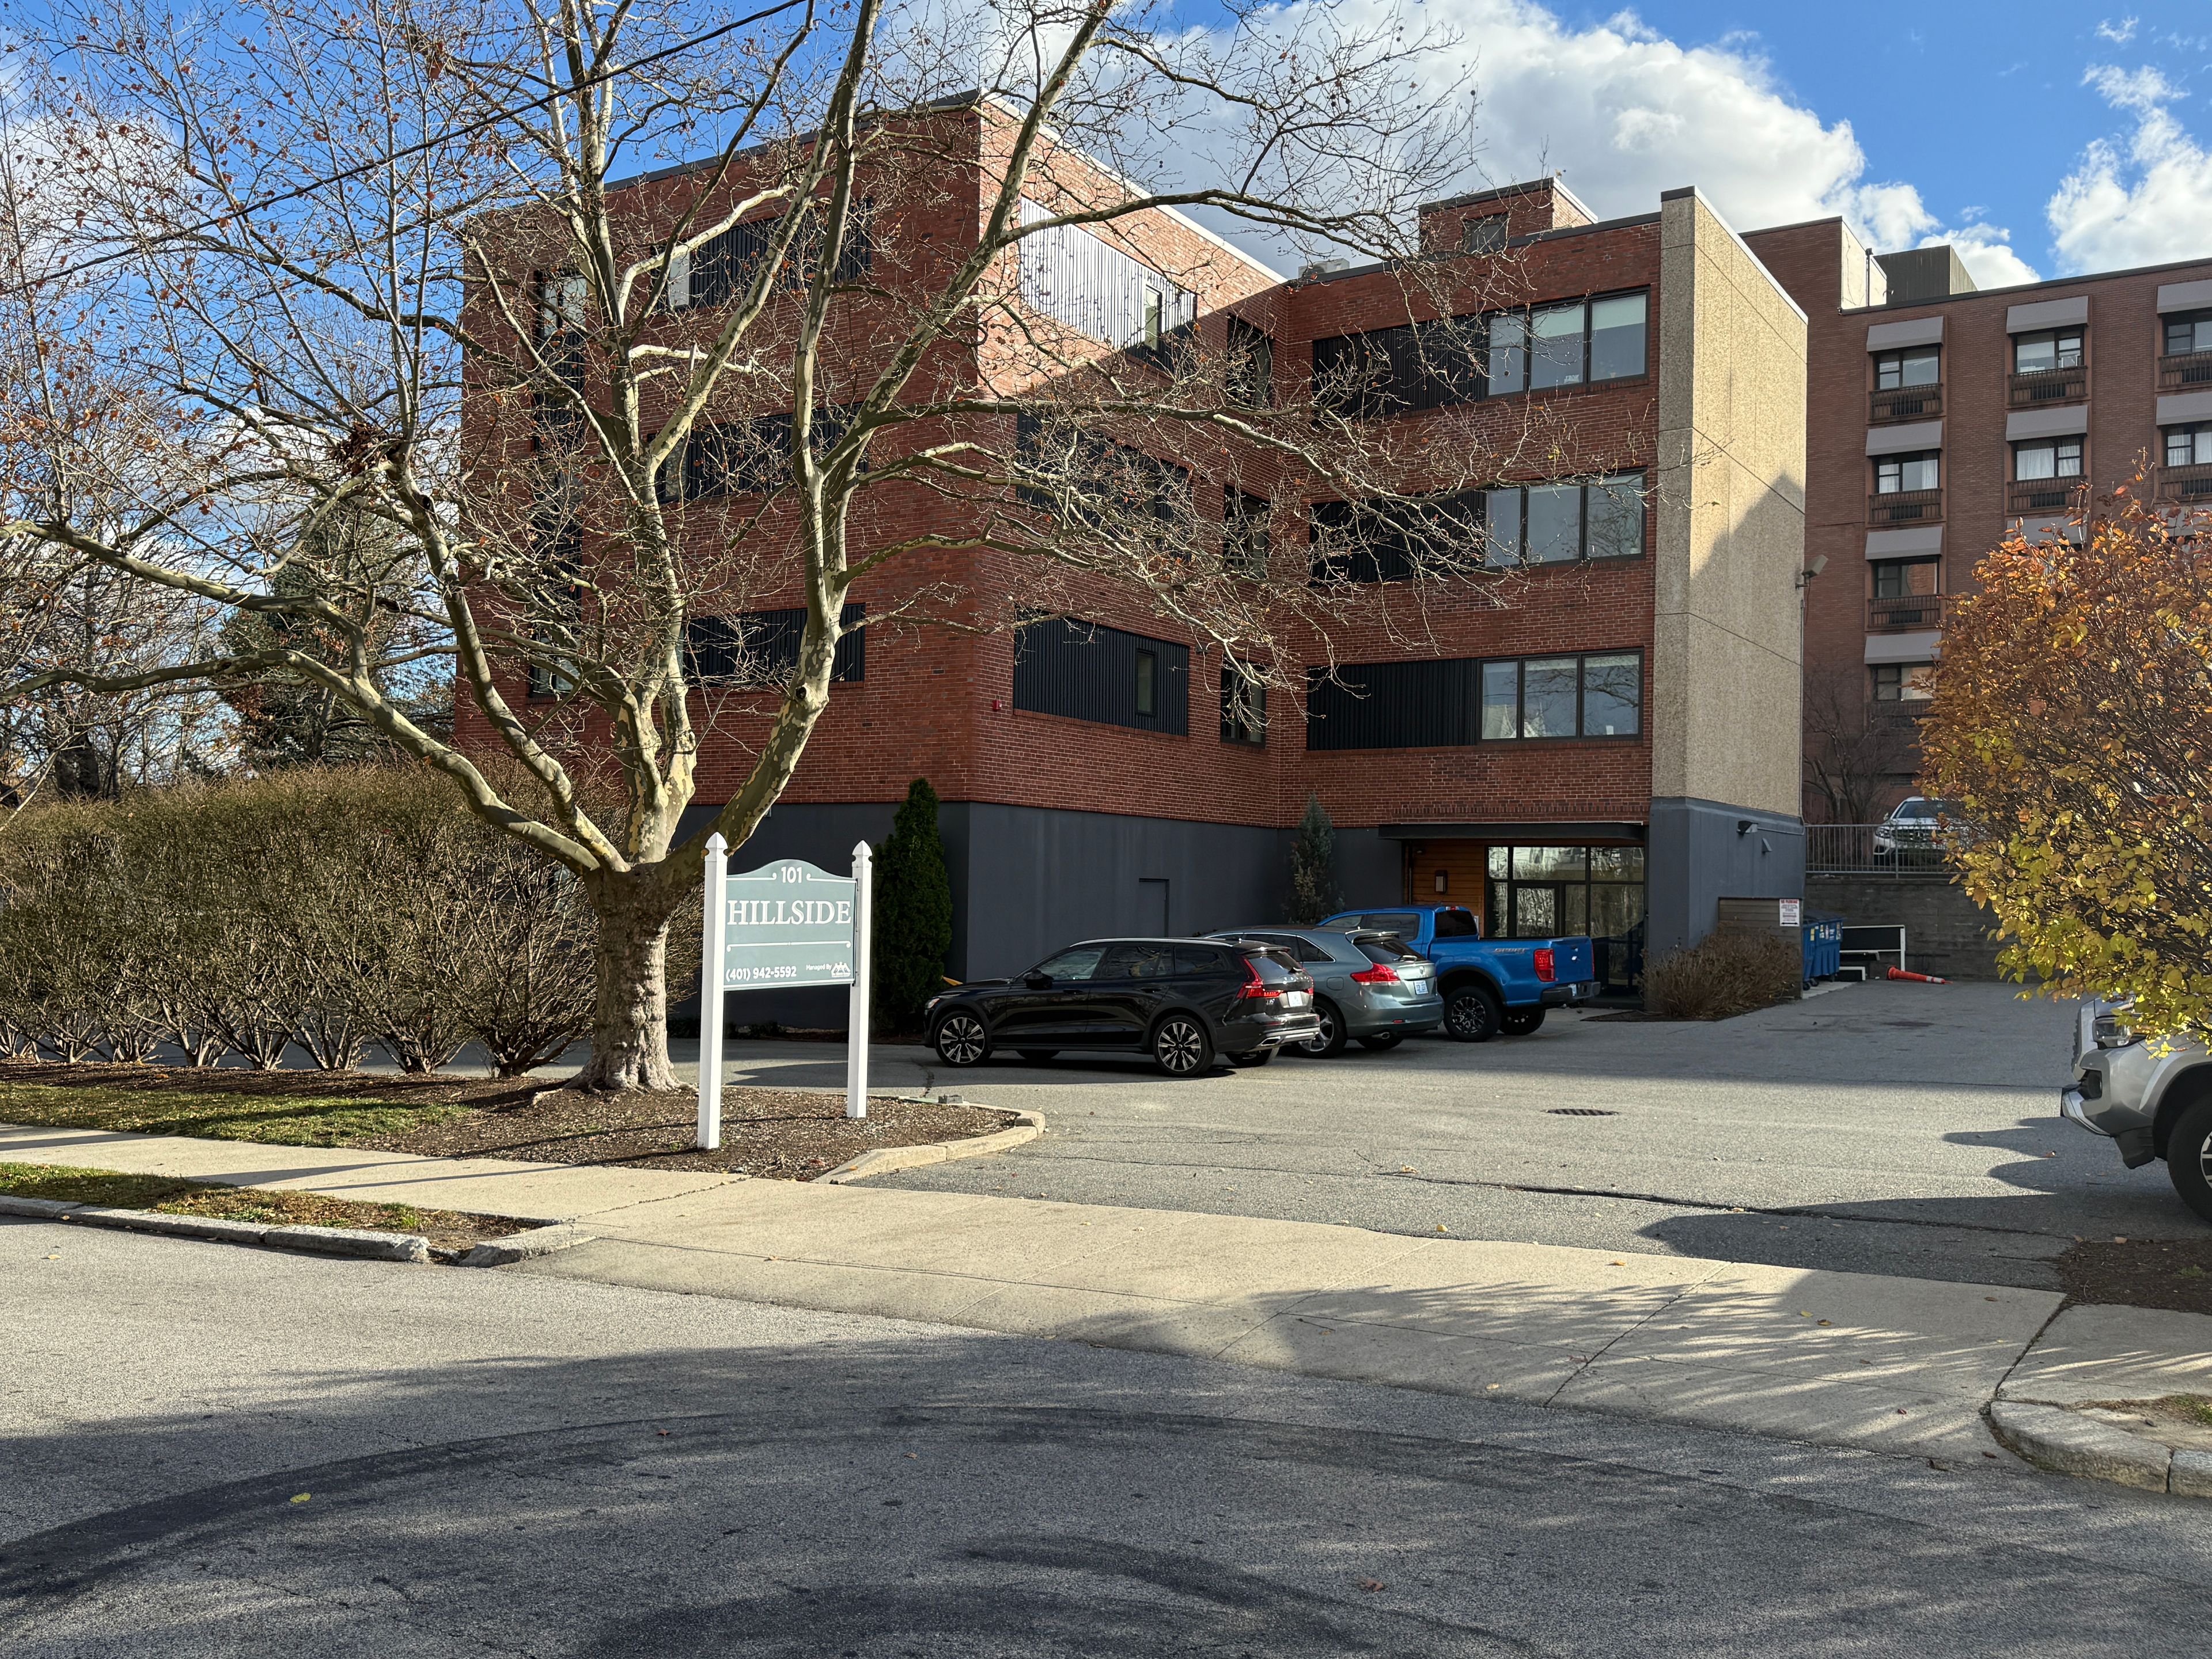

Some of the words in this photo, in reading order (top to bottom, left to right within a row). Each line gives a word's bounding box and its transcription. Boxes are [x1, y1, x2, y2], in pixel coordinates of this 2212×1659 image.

[781, 866, 802, 884] 101
[727, 900, 851, 925] HILLSIDE
[726, 968, 751, 982] (401)
[753, 965, 797, 979] 942-5592
